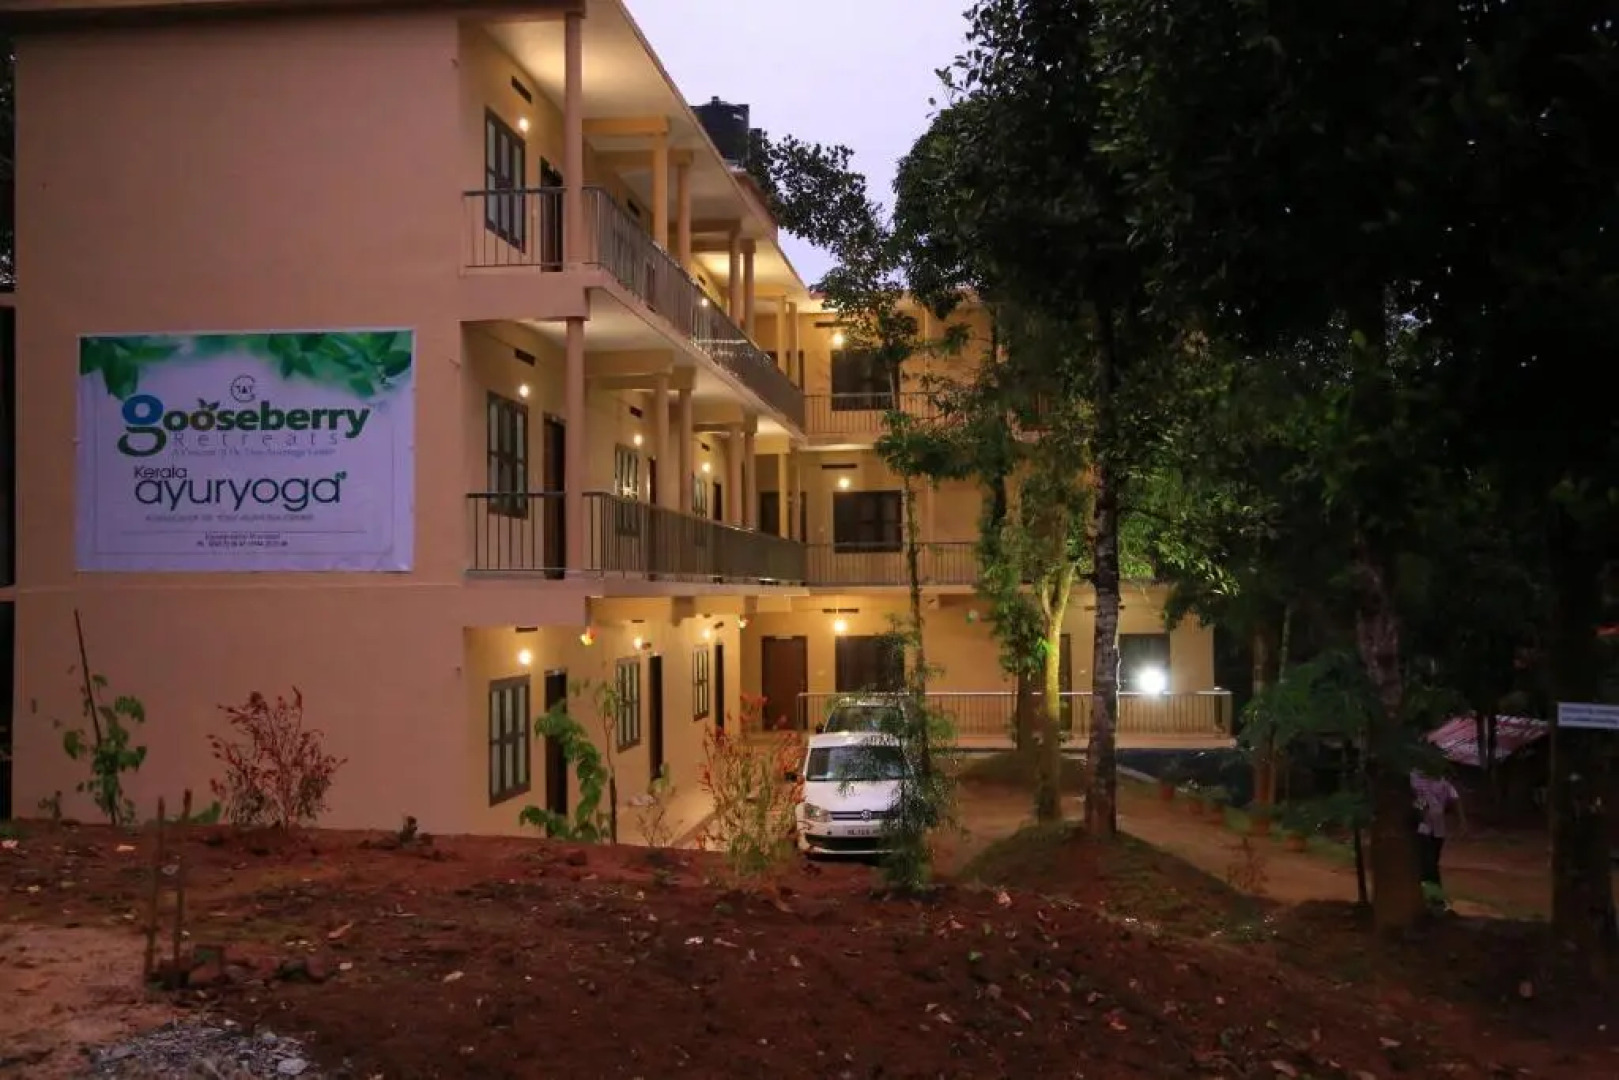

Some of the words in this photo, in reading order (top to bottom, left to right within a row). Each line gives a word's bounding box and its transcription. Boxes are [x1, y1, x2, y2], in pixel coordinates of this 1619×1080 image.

[117, 395, 371, 457] gooseberry
[174, 432, 338, 446] Retreats
[134, 465, 188, 479] Kerala
[135, 477, 341, 512] ayuryoga
